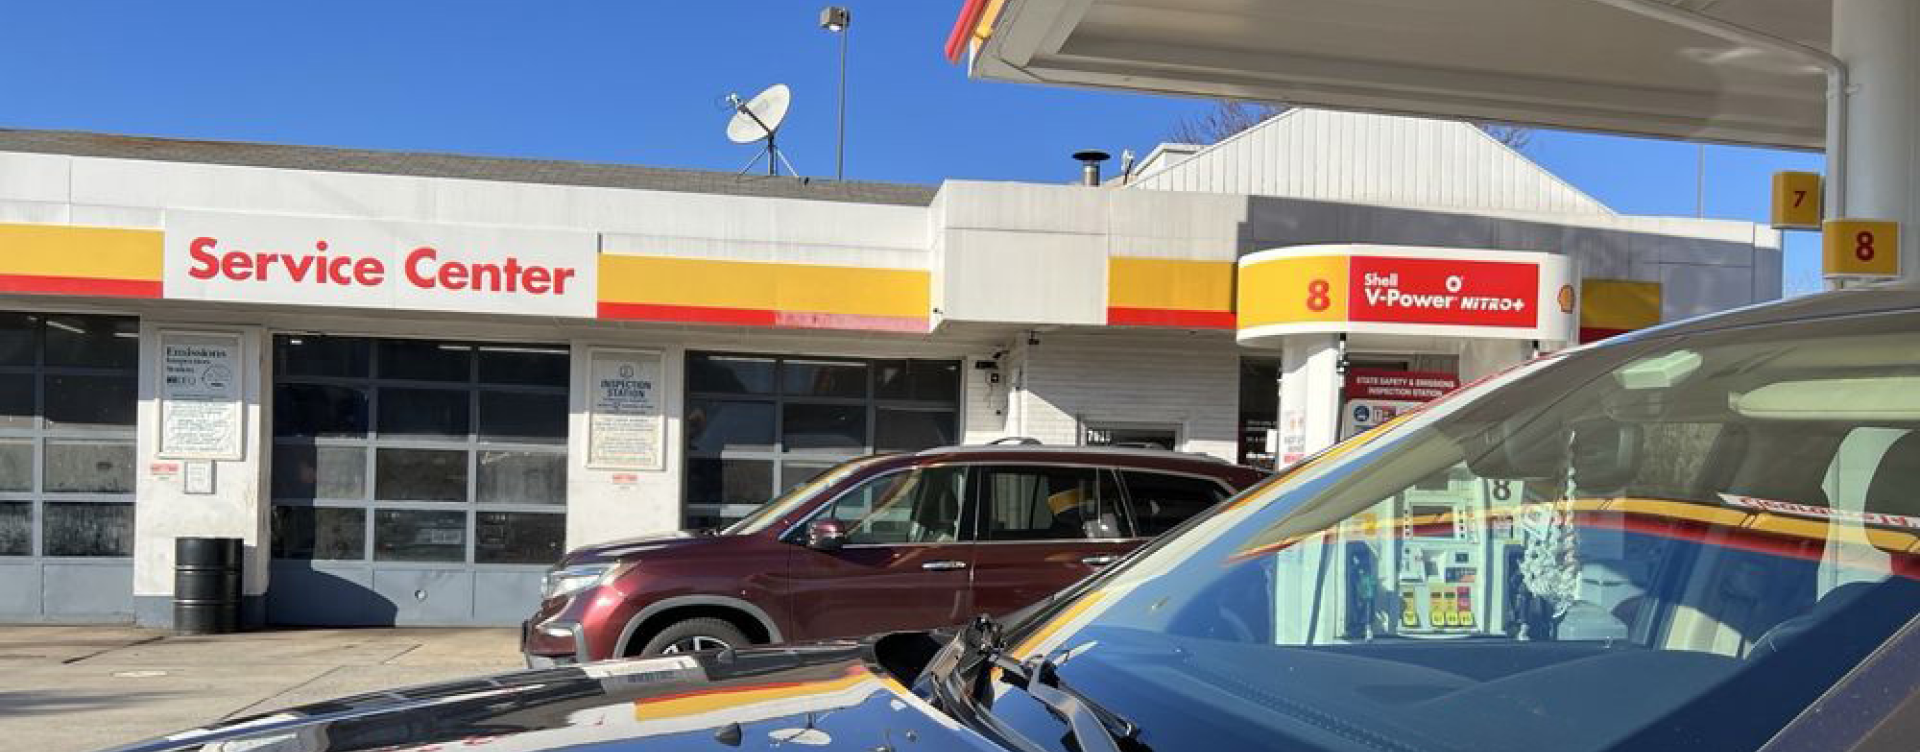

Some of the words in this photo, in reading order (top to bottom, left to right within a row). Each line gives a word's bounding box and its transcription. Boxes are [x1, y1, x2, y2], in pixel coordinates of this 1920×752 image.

[1793, 190, 1807, 208] 7
[1856, 230, 1874, 261] 8
[188, 236, 385, 286] Service
[404, 246, 575, 295] Center
[1364, 273, 1399, 287] Shell
[1306, 279, 1331, 312] 8
[1364, 288, 1452, 310] V-Power
[166, 346, 227, 358] Emissions
[600, 379, 652, 390] INSPECTION
[1356, 376, 1378, 384] STATE
[1380, 376, 1407, 386] SAFETY
[1416, 378, 1454, 388] EMISSIONS
[608, 388, 645, 398] STATION
[1368, 386, 1412, 396] INSPECTION
[1413, 388, 1443, 398] STATION
[1493, 479, 1512, 501] 8
